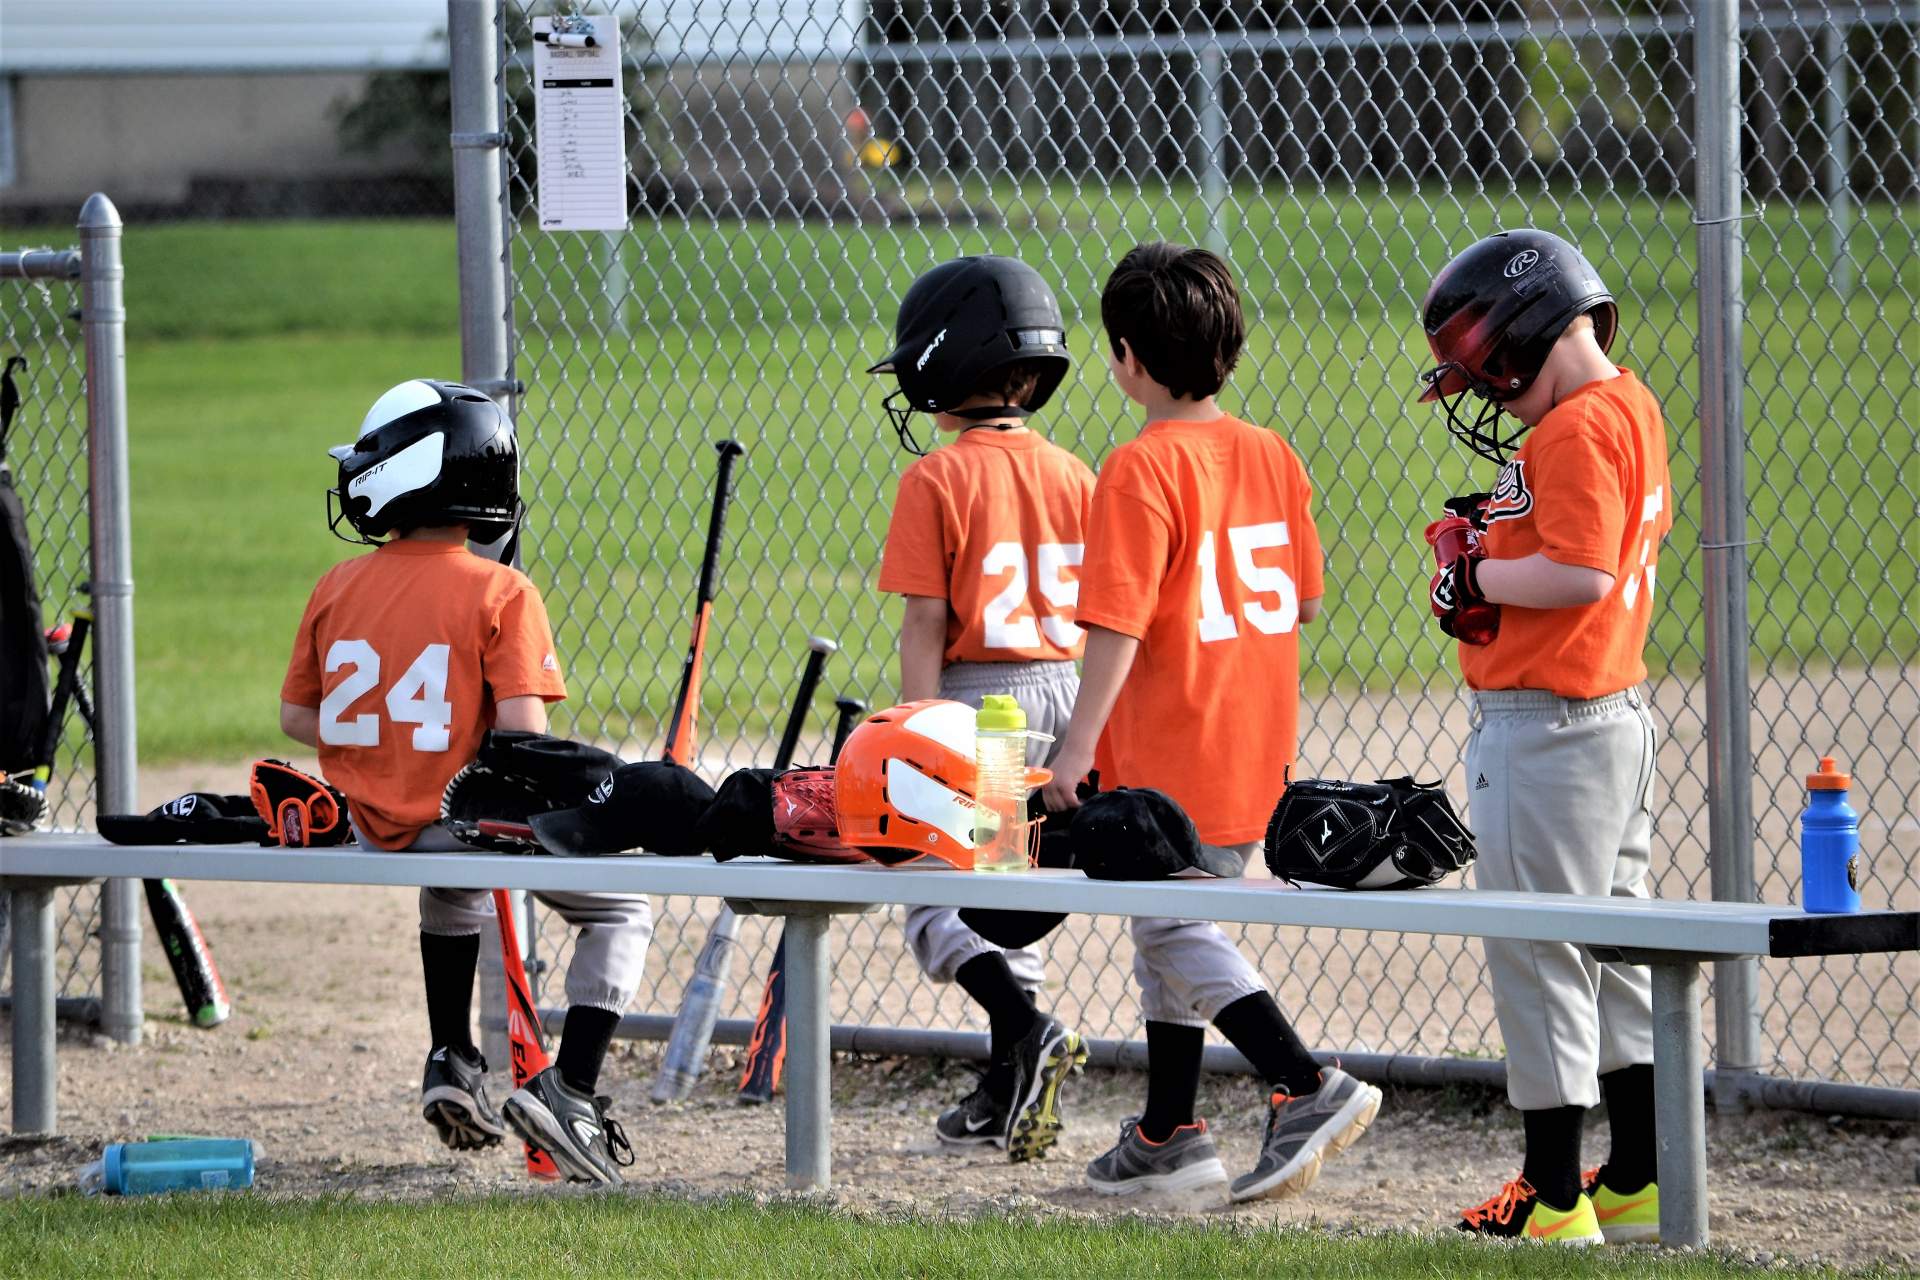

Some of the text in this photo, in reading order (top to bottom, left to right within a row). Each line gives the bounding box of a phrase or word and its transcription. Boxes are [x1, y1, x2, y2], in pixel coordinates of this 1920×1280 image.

[916, 328, 947, 371] RIP-IT
[355, 462, 388, 487] RIP-IT
[982, 542, 1087, 648] 25
[1196, 521, 1300, 643] 15
[319, 640, 451, 751] 24
